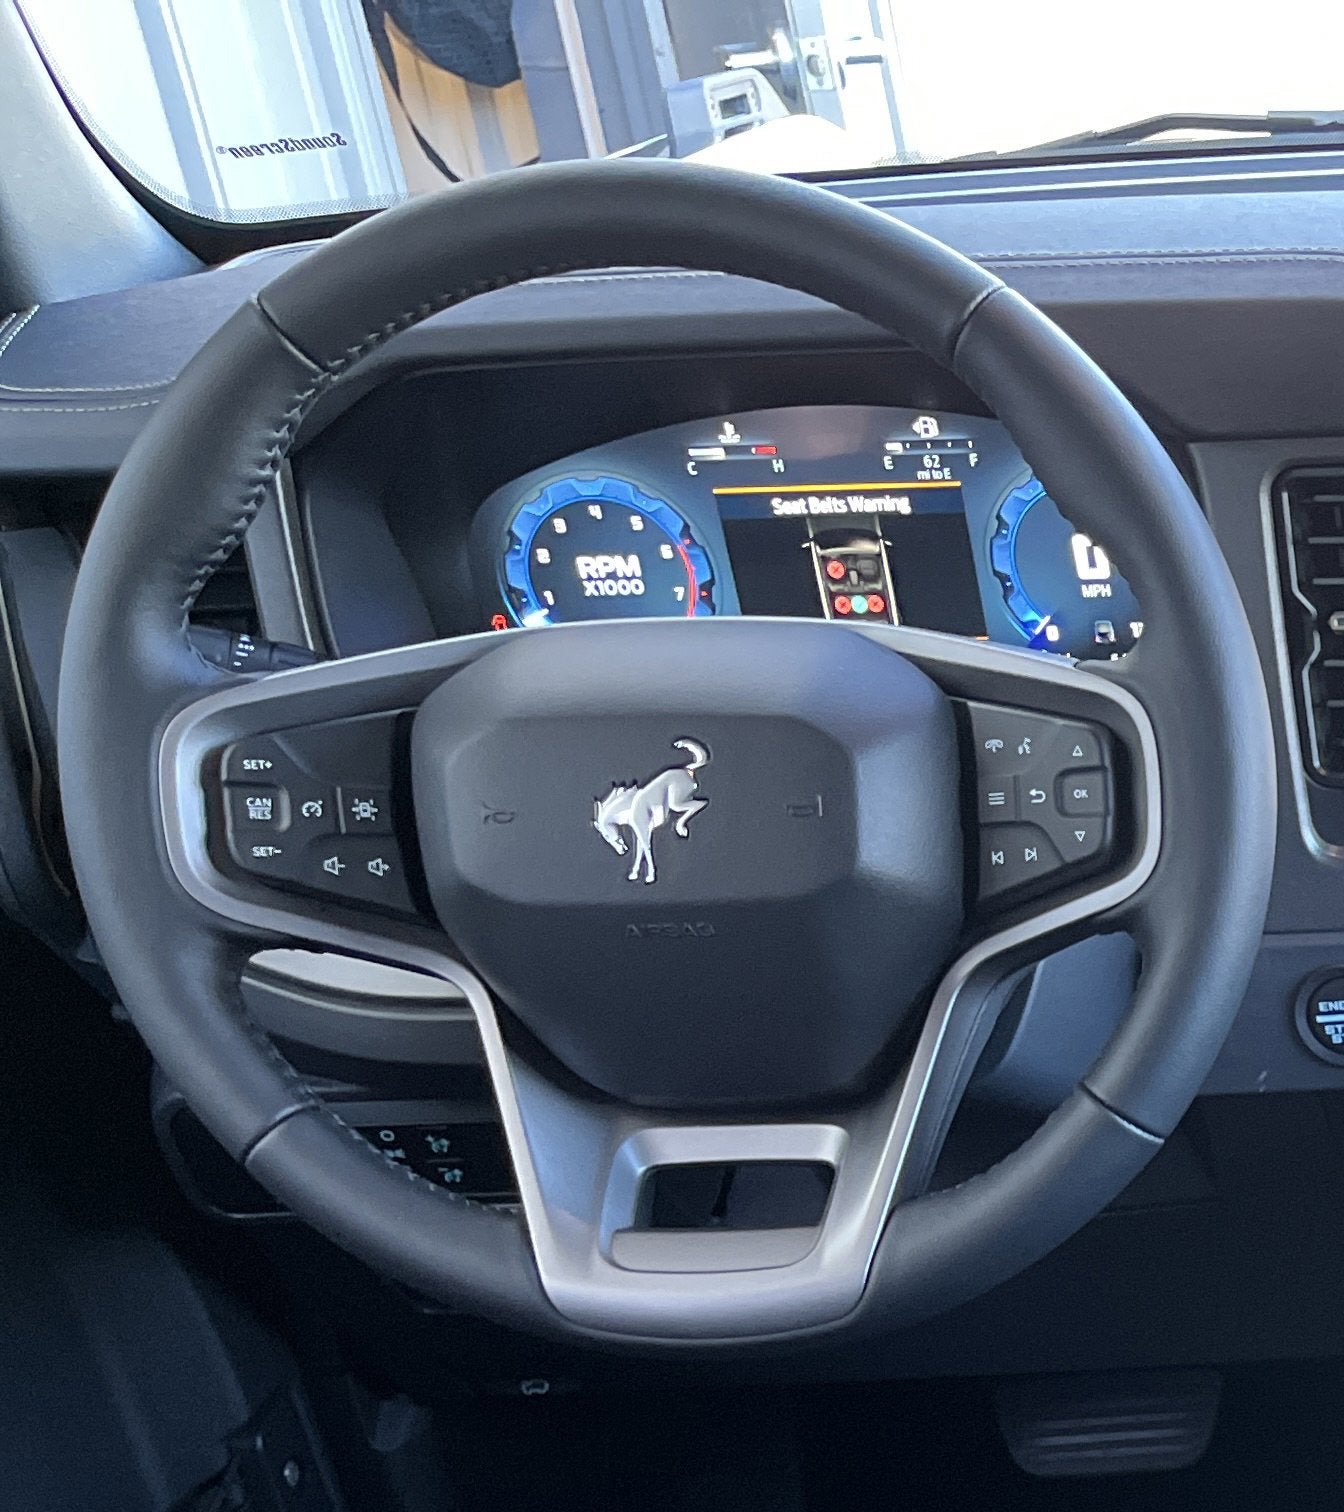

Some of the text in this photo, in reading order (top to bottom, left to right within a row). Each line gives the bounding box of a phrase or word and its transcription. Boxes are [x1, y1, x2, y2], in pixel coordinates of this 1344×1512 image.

[686, 461, 698, 476] C
[772, 459, 785, 473] H
[883, 455, 895, 471] E
[923, 454, 942, 469] 62
[916, 468, 930, 481] mi
[943, 467, 952, 481] E
[587, 504, 602, 520] 4
[770, 495, 912, 516] Seat Belts Warning
[630, 515, 644, 531] 5
[575, 554, 642, 580] RPM
[582, 579, 645, 597] X1000
[673, 586, 685, 602] 7
[1081, 583, 1112, 598] MPH
[543, 590, 555, 606] 1
[1073, 788, 1089, 799] OK
[246, 797, 273, 809] CAN
